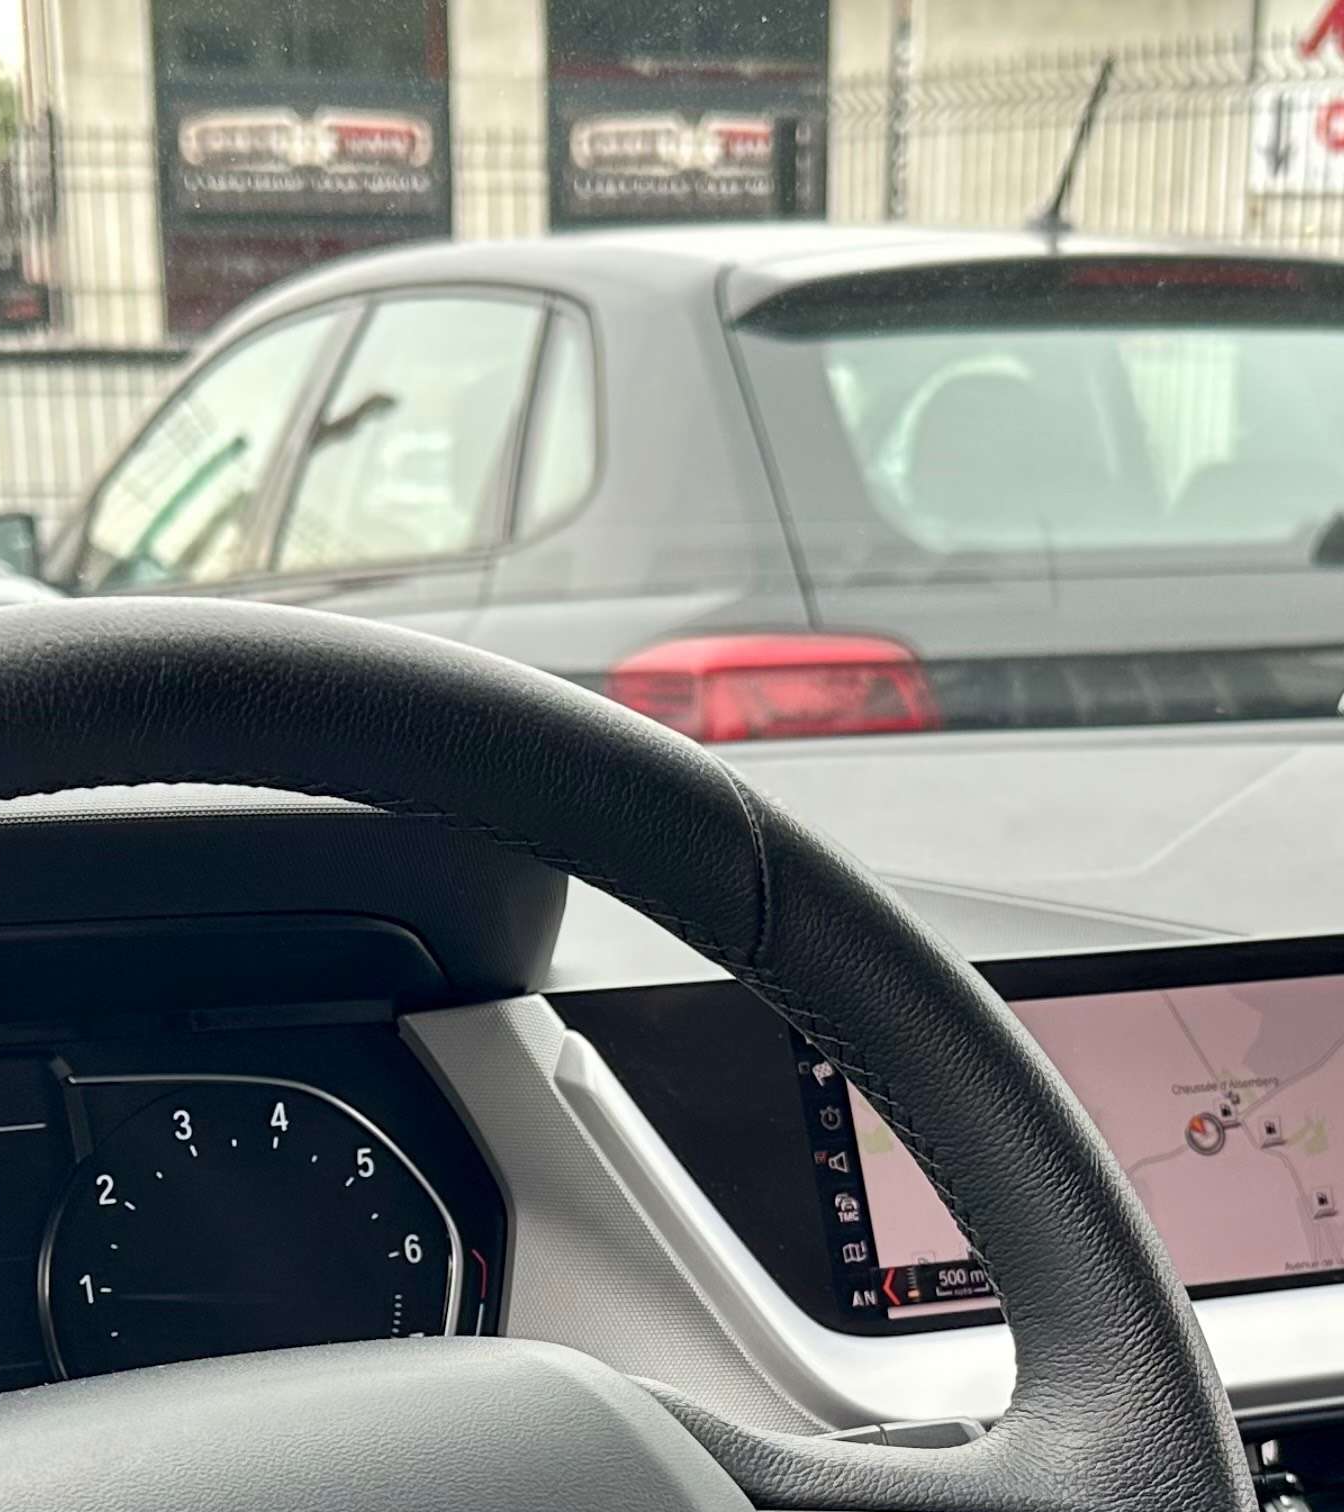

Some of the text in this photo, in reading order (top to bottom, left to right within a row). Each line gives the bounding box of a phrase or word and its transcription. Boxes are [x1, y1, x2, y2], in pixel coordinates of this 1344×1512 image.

[173, 1110, 193, 1140] 3
[270, 1102, 289, 1132] 4
[357, 1148, 375, 1179] 5
[96, 1175, 117, 1205] 2
[404, 1234, 423, 1264] 6
[80, 1275, 94, 1304] 1
[938, 1269, 985, 1287] 500 m
